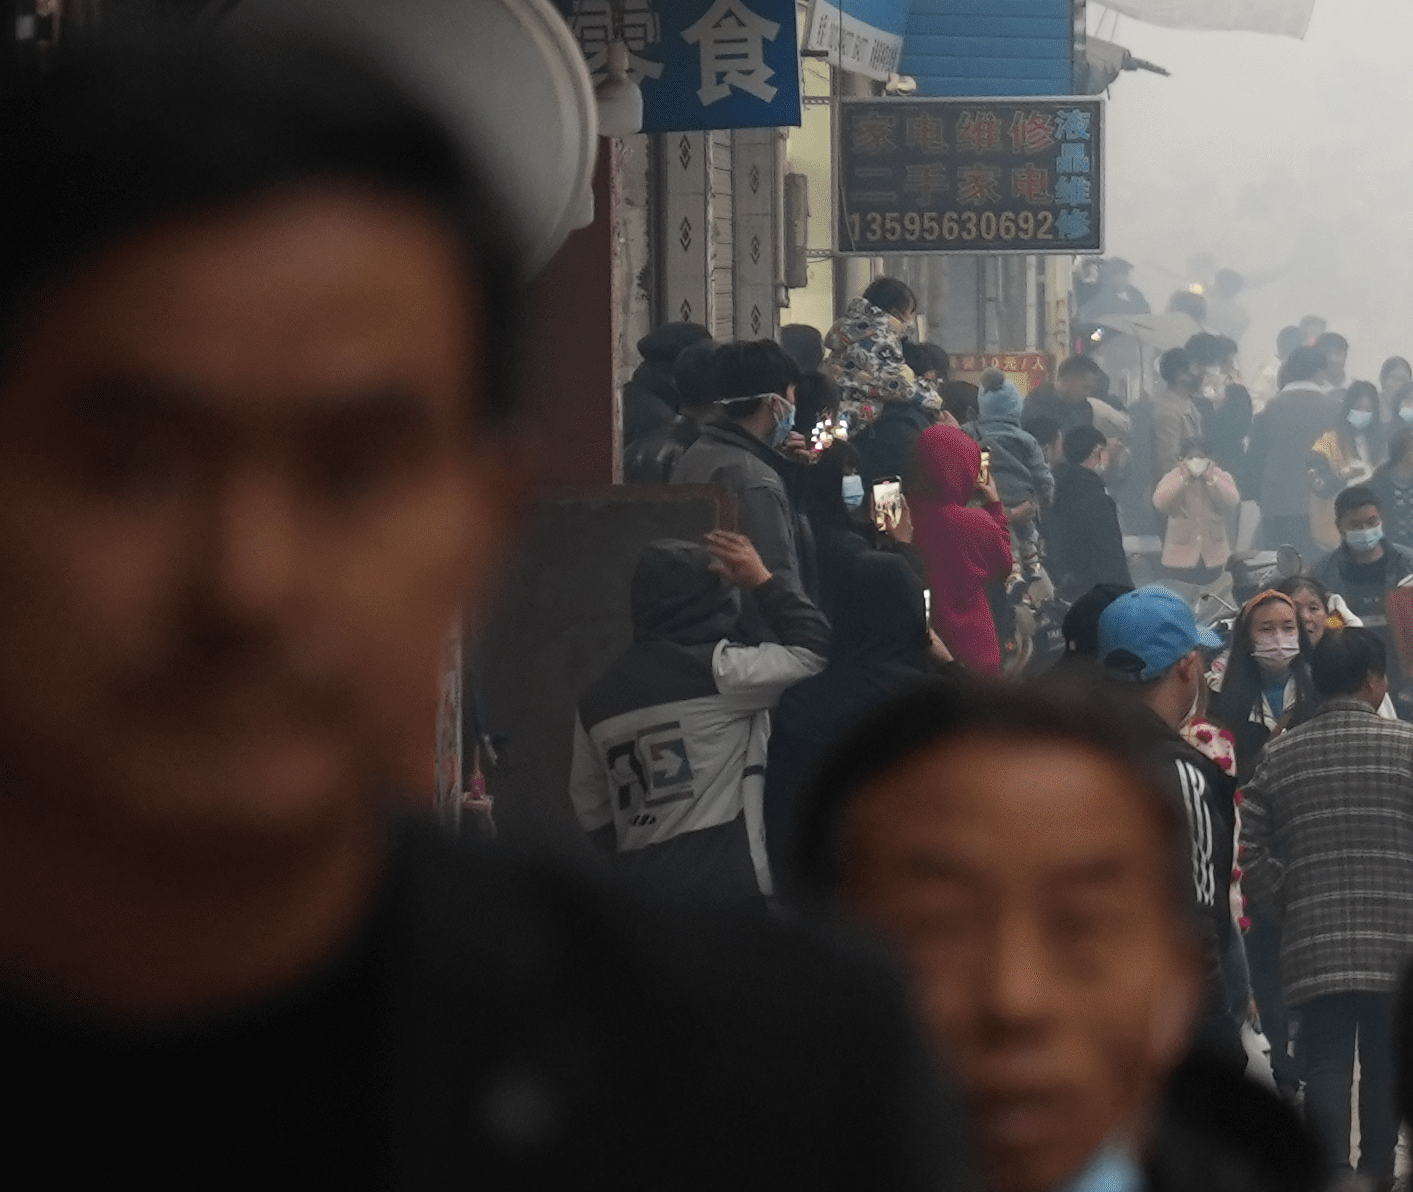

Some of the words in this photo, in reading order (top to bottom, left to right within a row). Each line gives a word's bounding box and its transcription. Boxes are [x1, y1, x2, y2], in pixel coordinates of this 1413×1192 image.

[851, 111, 1055, 157] 家电维修
[850, 162, 1053, 206] 二手家电
[1054, 108, 1092, 241] 液晶维修
[850, 210, 1054, 241] 13595630692
